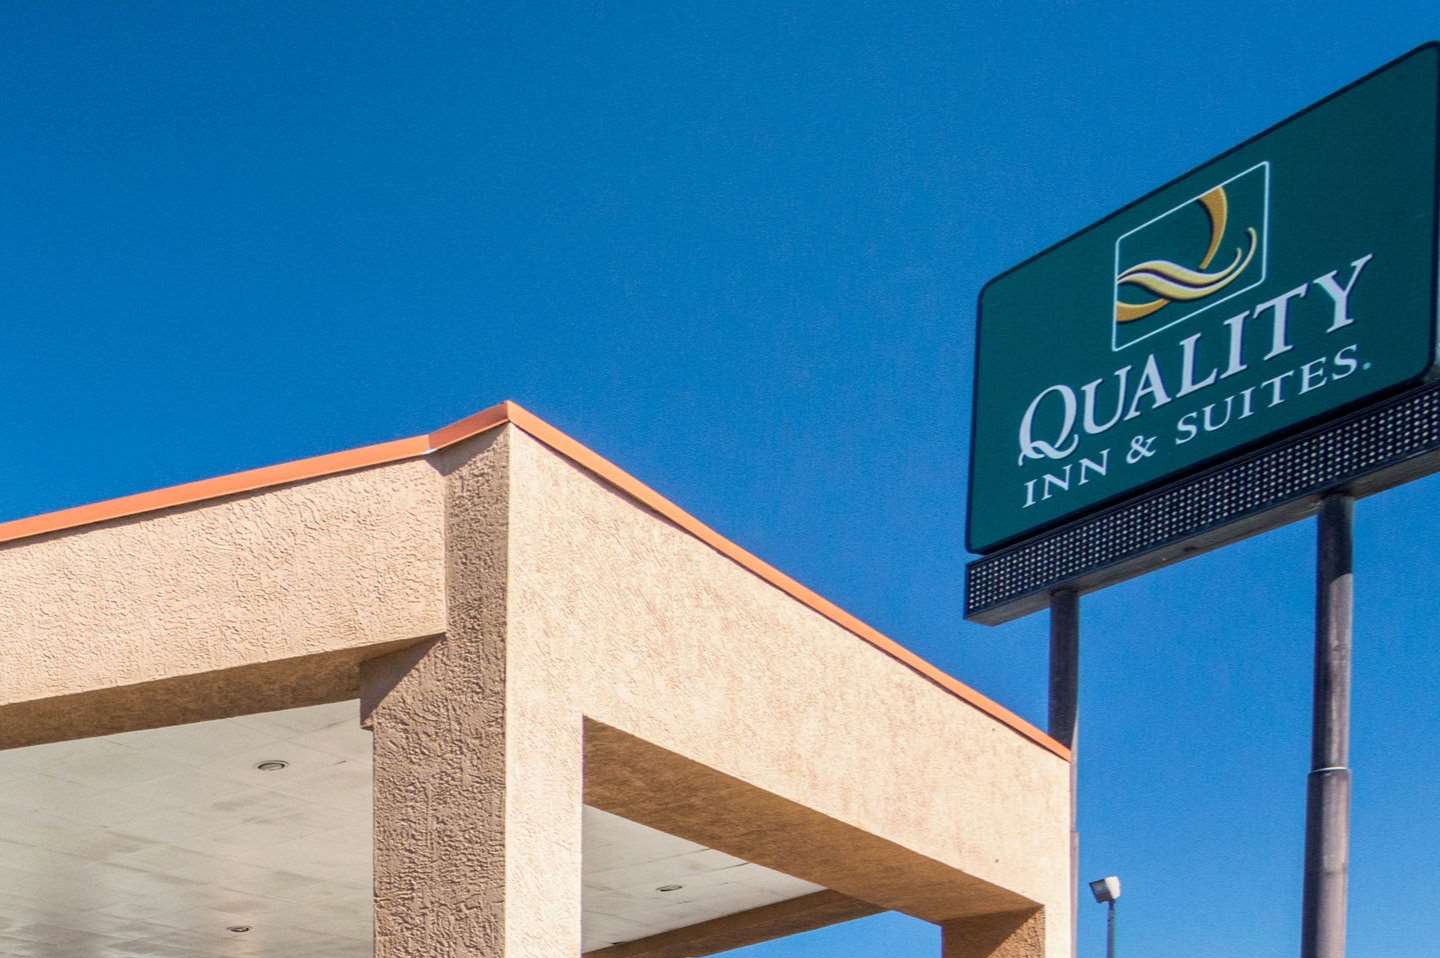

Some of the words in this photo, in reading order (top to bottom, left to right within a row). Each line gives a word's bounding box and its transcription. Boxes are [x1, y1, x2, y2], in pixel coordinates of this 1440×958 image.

[1018, 253, 1373, 466] QUALITY
[1022, 449, 1110, 509] INN
[1126, 435, 1158, 464] &
